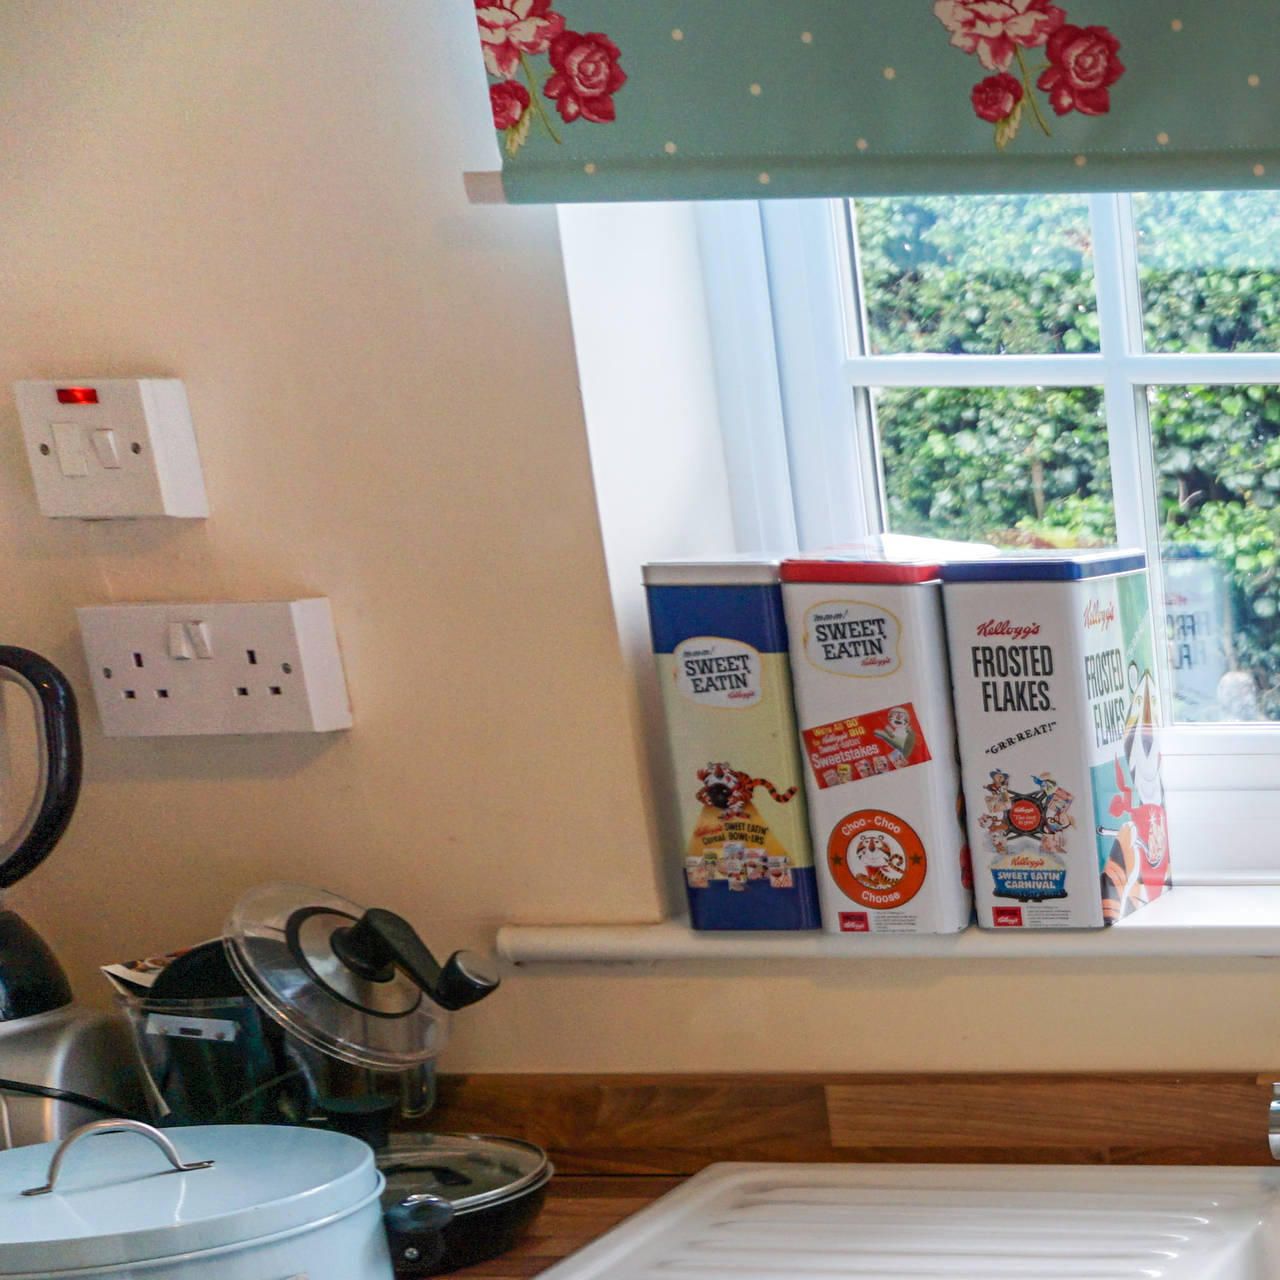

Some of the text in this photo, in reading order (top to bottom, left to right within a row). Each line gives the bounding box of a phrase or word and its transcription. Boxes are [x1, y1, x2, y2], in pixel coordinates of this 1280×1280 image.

[815, 618, 885, 642] SWEET
[977, 619, 1040, 640] Kellogg's
[685, 655, 749, 677] SWEET
[972, 645, 1053, 677] FROSTED
[1084, 648, 1124, 700] FROSTED
[982, 680, 1051, 712] FLAKES
[1093, 697, 1126, 748] FLAKES
[841, 816, 901, 836] Choo Choo
[997, 871, 1028, 881] SWEET
[1005, 881, 1056, 890] CARNIVAL
[862, 890, 901, 904] Choose
